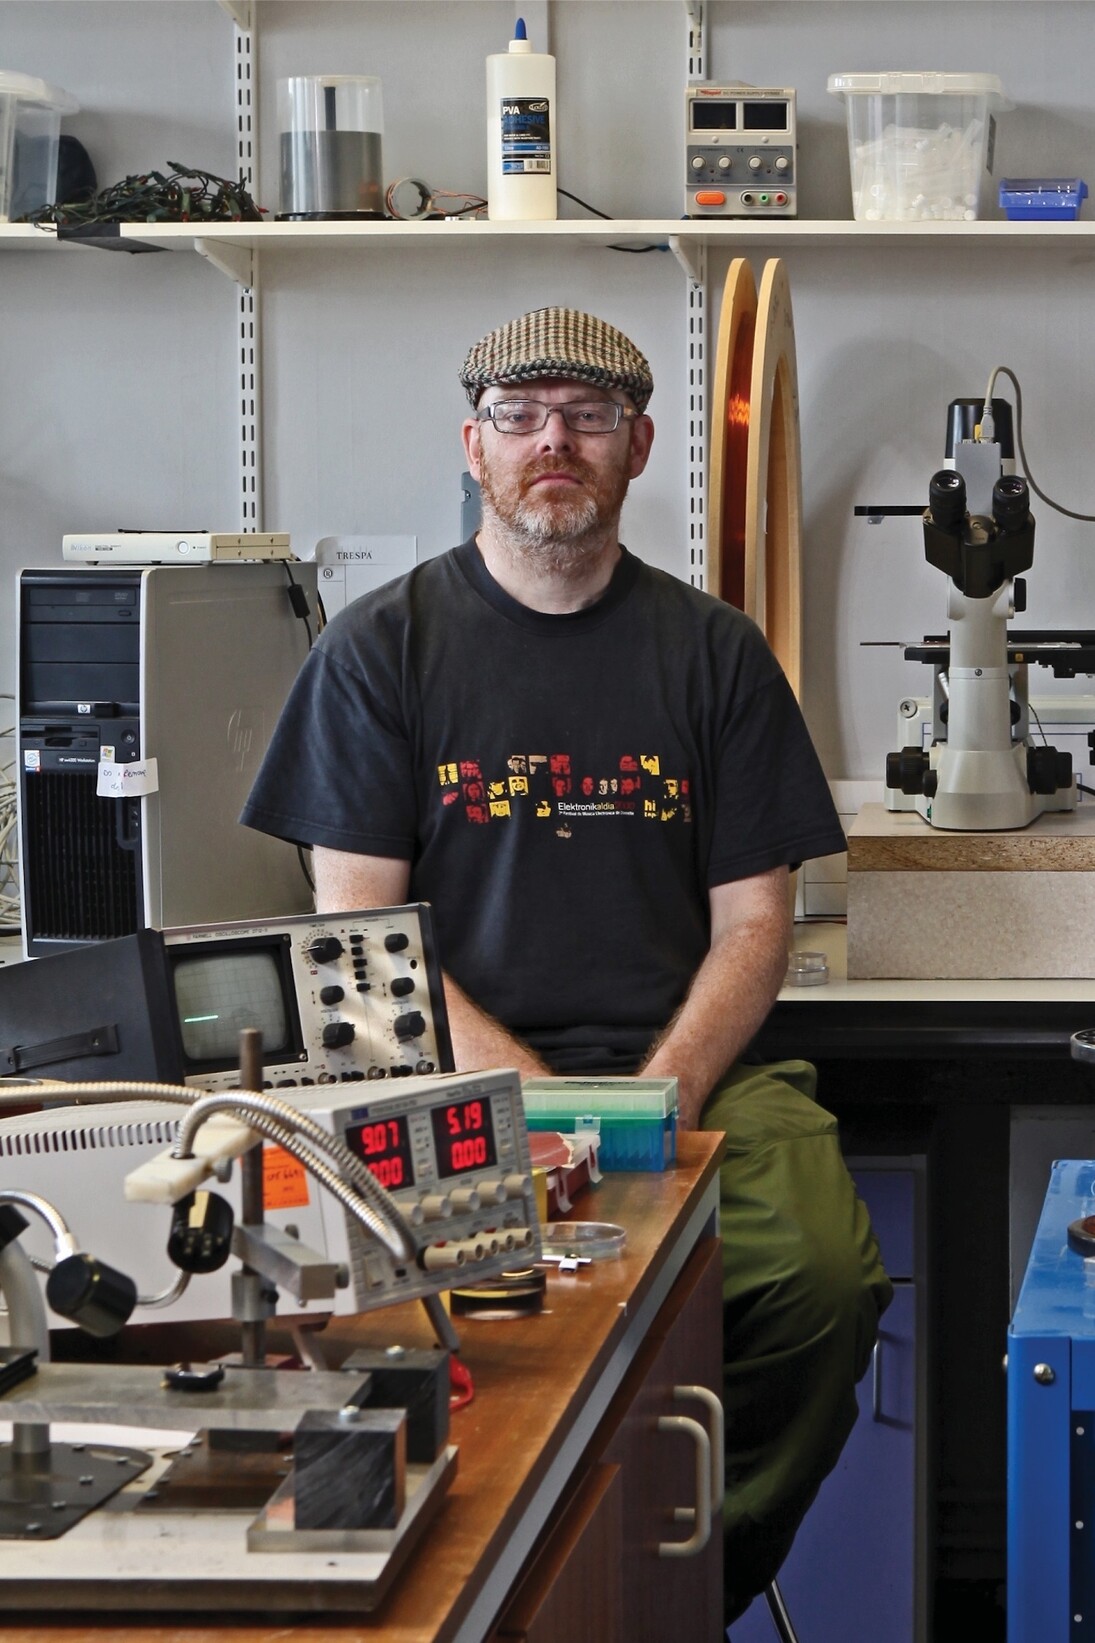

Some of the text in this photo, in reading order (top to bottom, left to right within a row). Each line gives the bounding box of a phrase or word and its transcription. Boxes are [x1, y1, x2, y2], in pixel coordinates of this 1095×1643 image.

[502, 105, 520, 115] PVA
[503, 114, 545, 124] ADHESIVE
[336, 551, 372, 560] TRESPA
[557, 802, 615, 811] Elektronikaldia
[644, 799, 656, 811] hi
